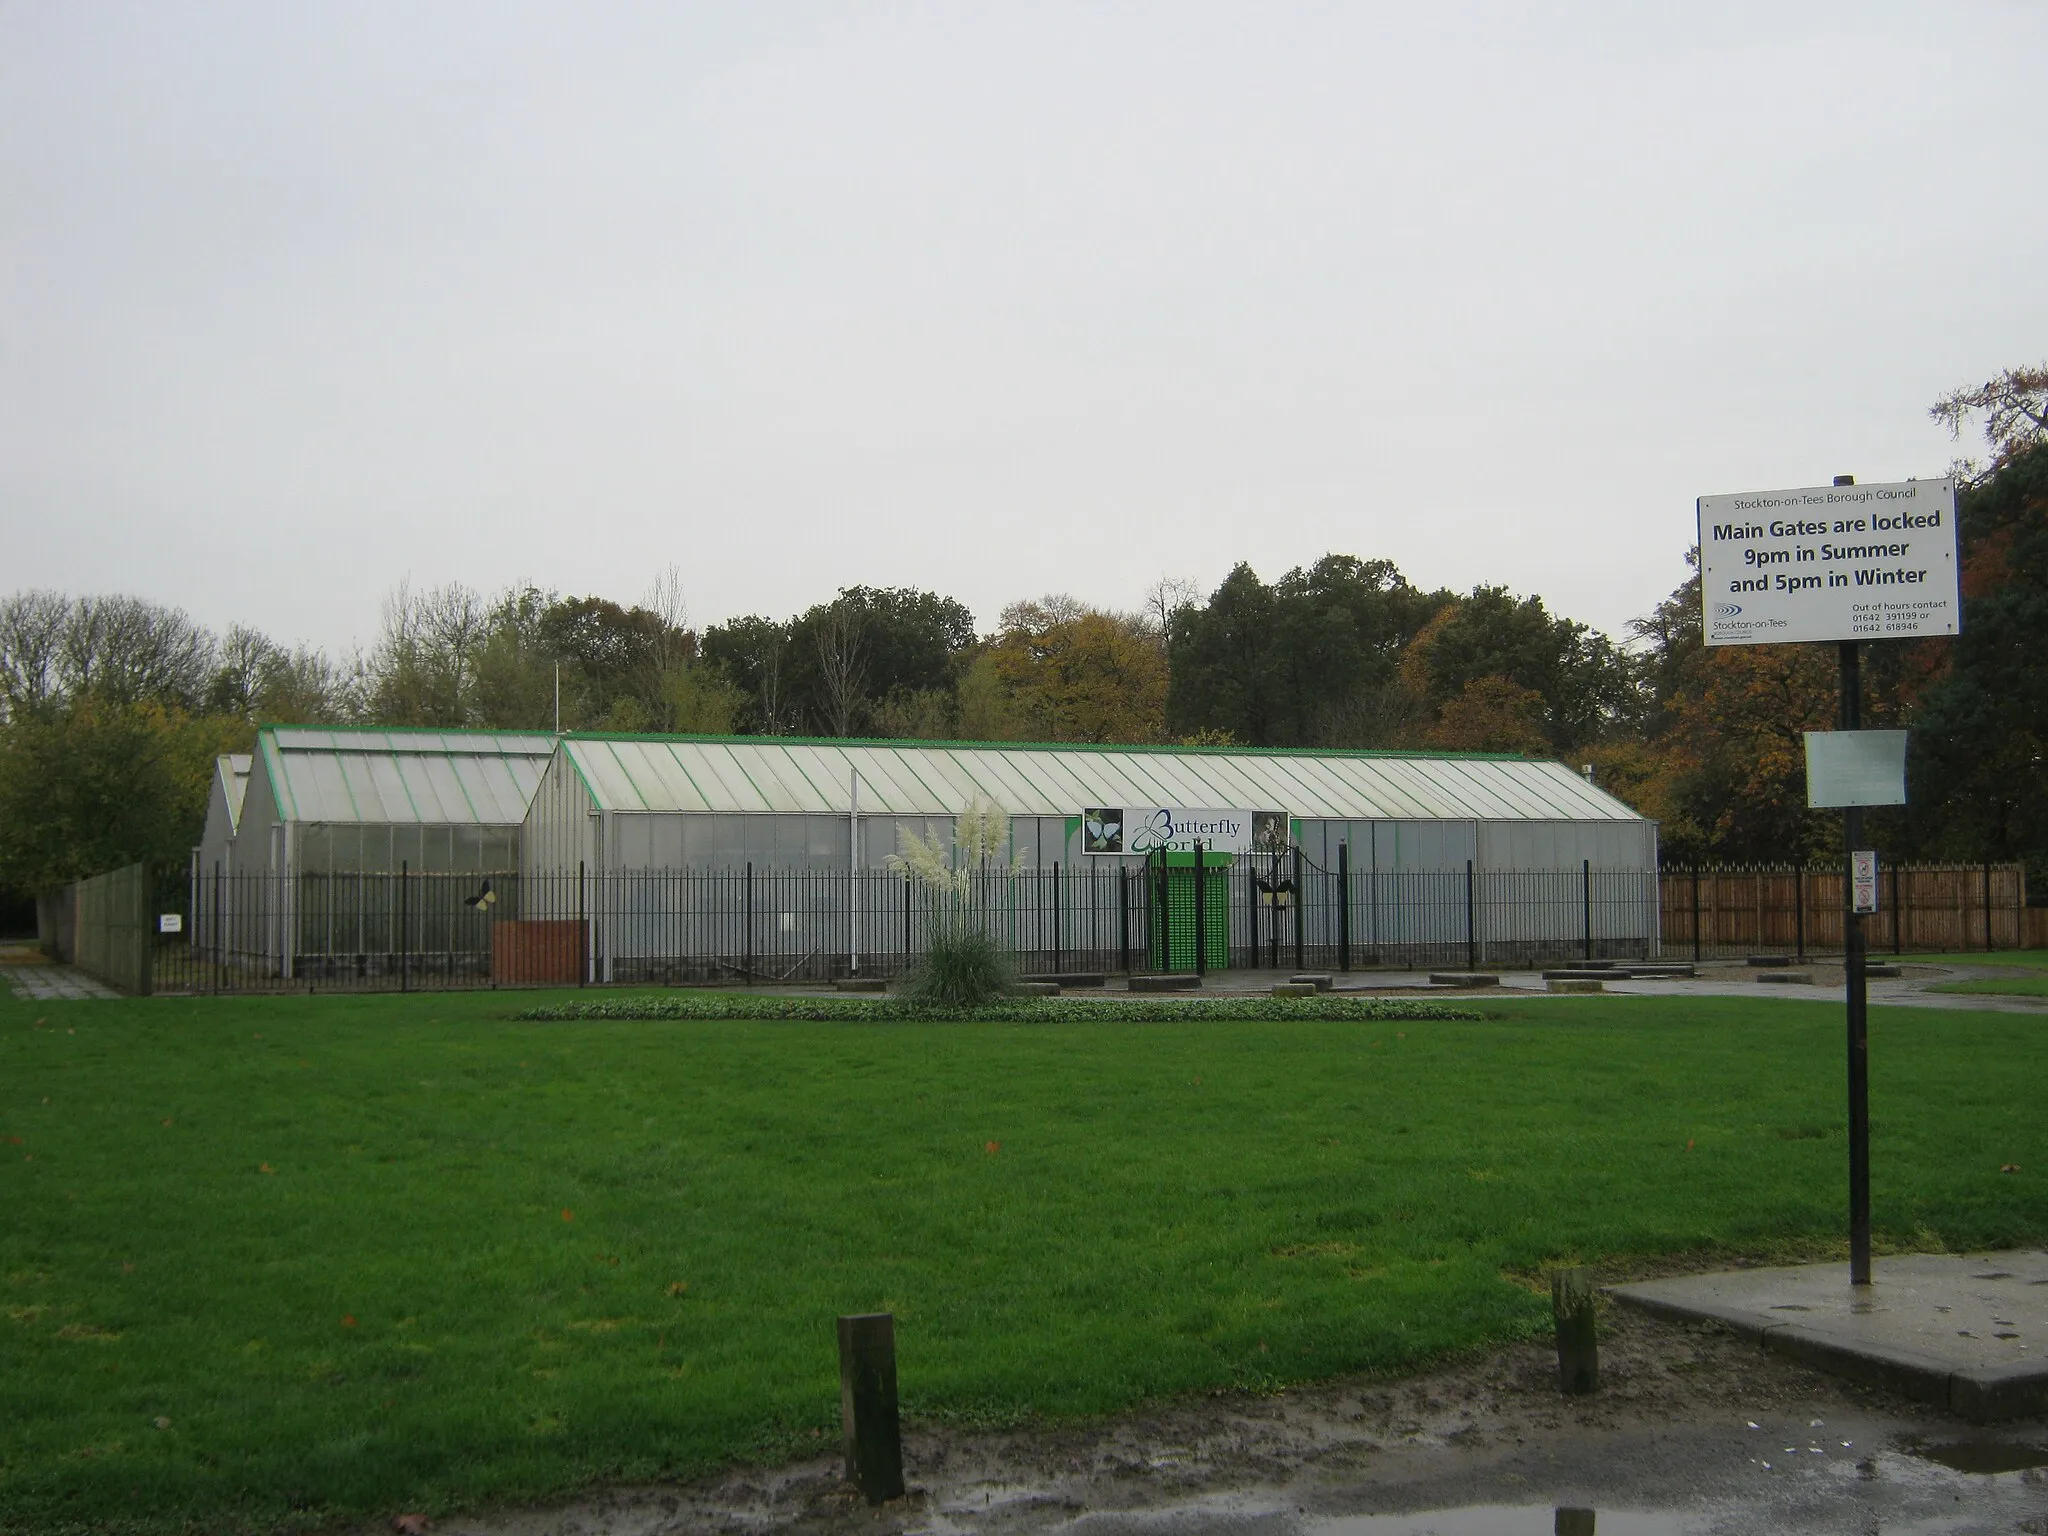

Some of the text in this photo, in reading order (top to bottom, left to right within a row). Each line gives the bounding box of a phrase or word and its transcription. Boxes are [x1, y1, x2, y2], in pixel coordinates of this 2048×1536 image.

[1734, 488, 1916, 509] Stockton-on-Tees Borough Council
[1713, 510, 1941, 540] Main Gates are locked
[1744, 543, 1910, 568] 9pm in Summer
[1729, 568, 1927, 593] and 5pm in Winter
[1852, 604, 1869, 612] Out
[1872, 603, 1882, 611] of
[1912, 601, 1947, 609] contact
[1852, 613, 1880, 622] 01642
[1886, 612, 1917, 621] 391199
[1713, 619, 1788, 630] Stockton-on-Tees
[1853, 622, 1918, 632] 01642 618946
[1149, 809, 1240, 838] Butterfly
